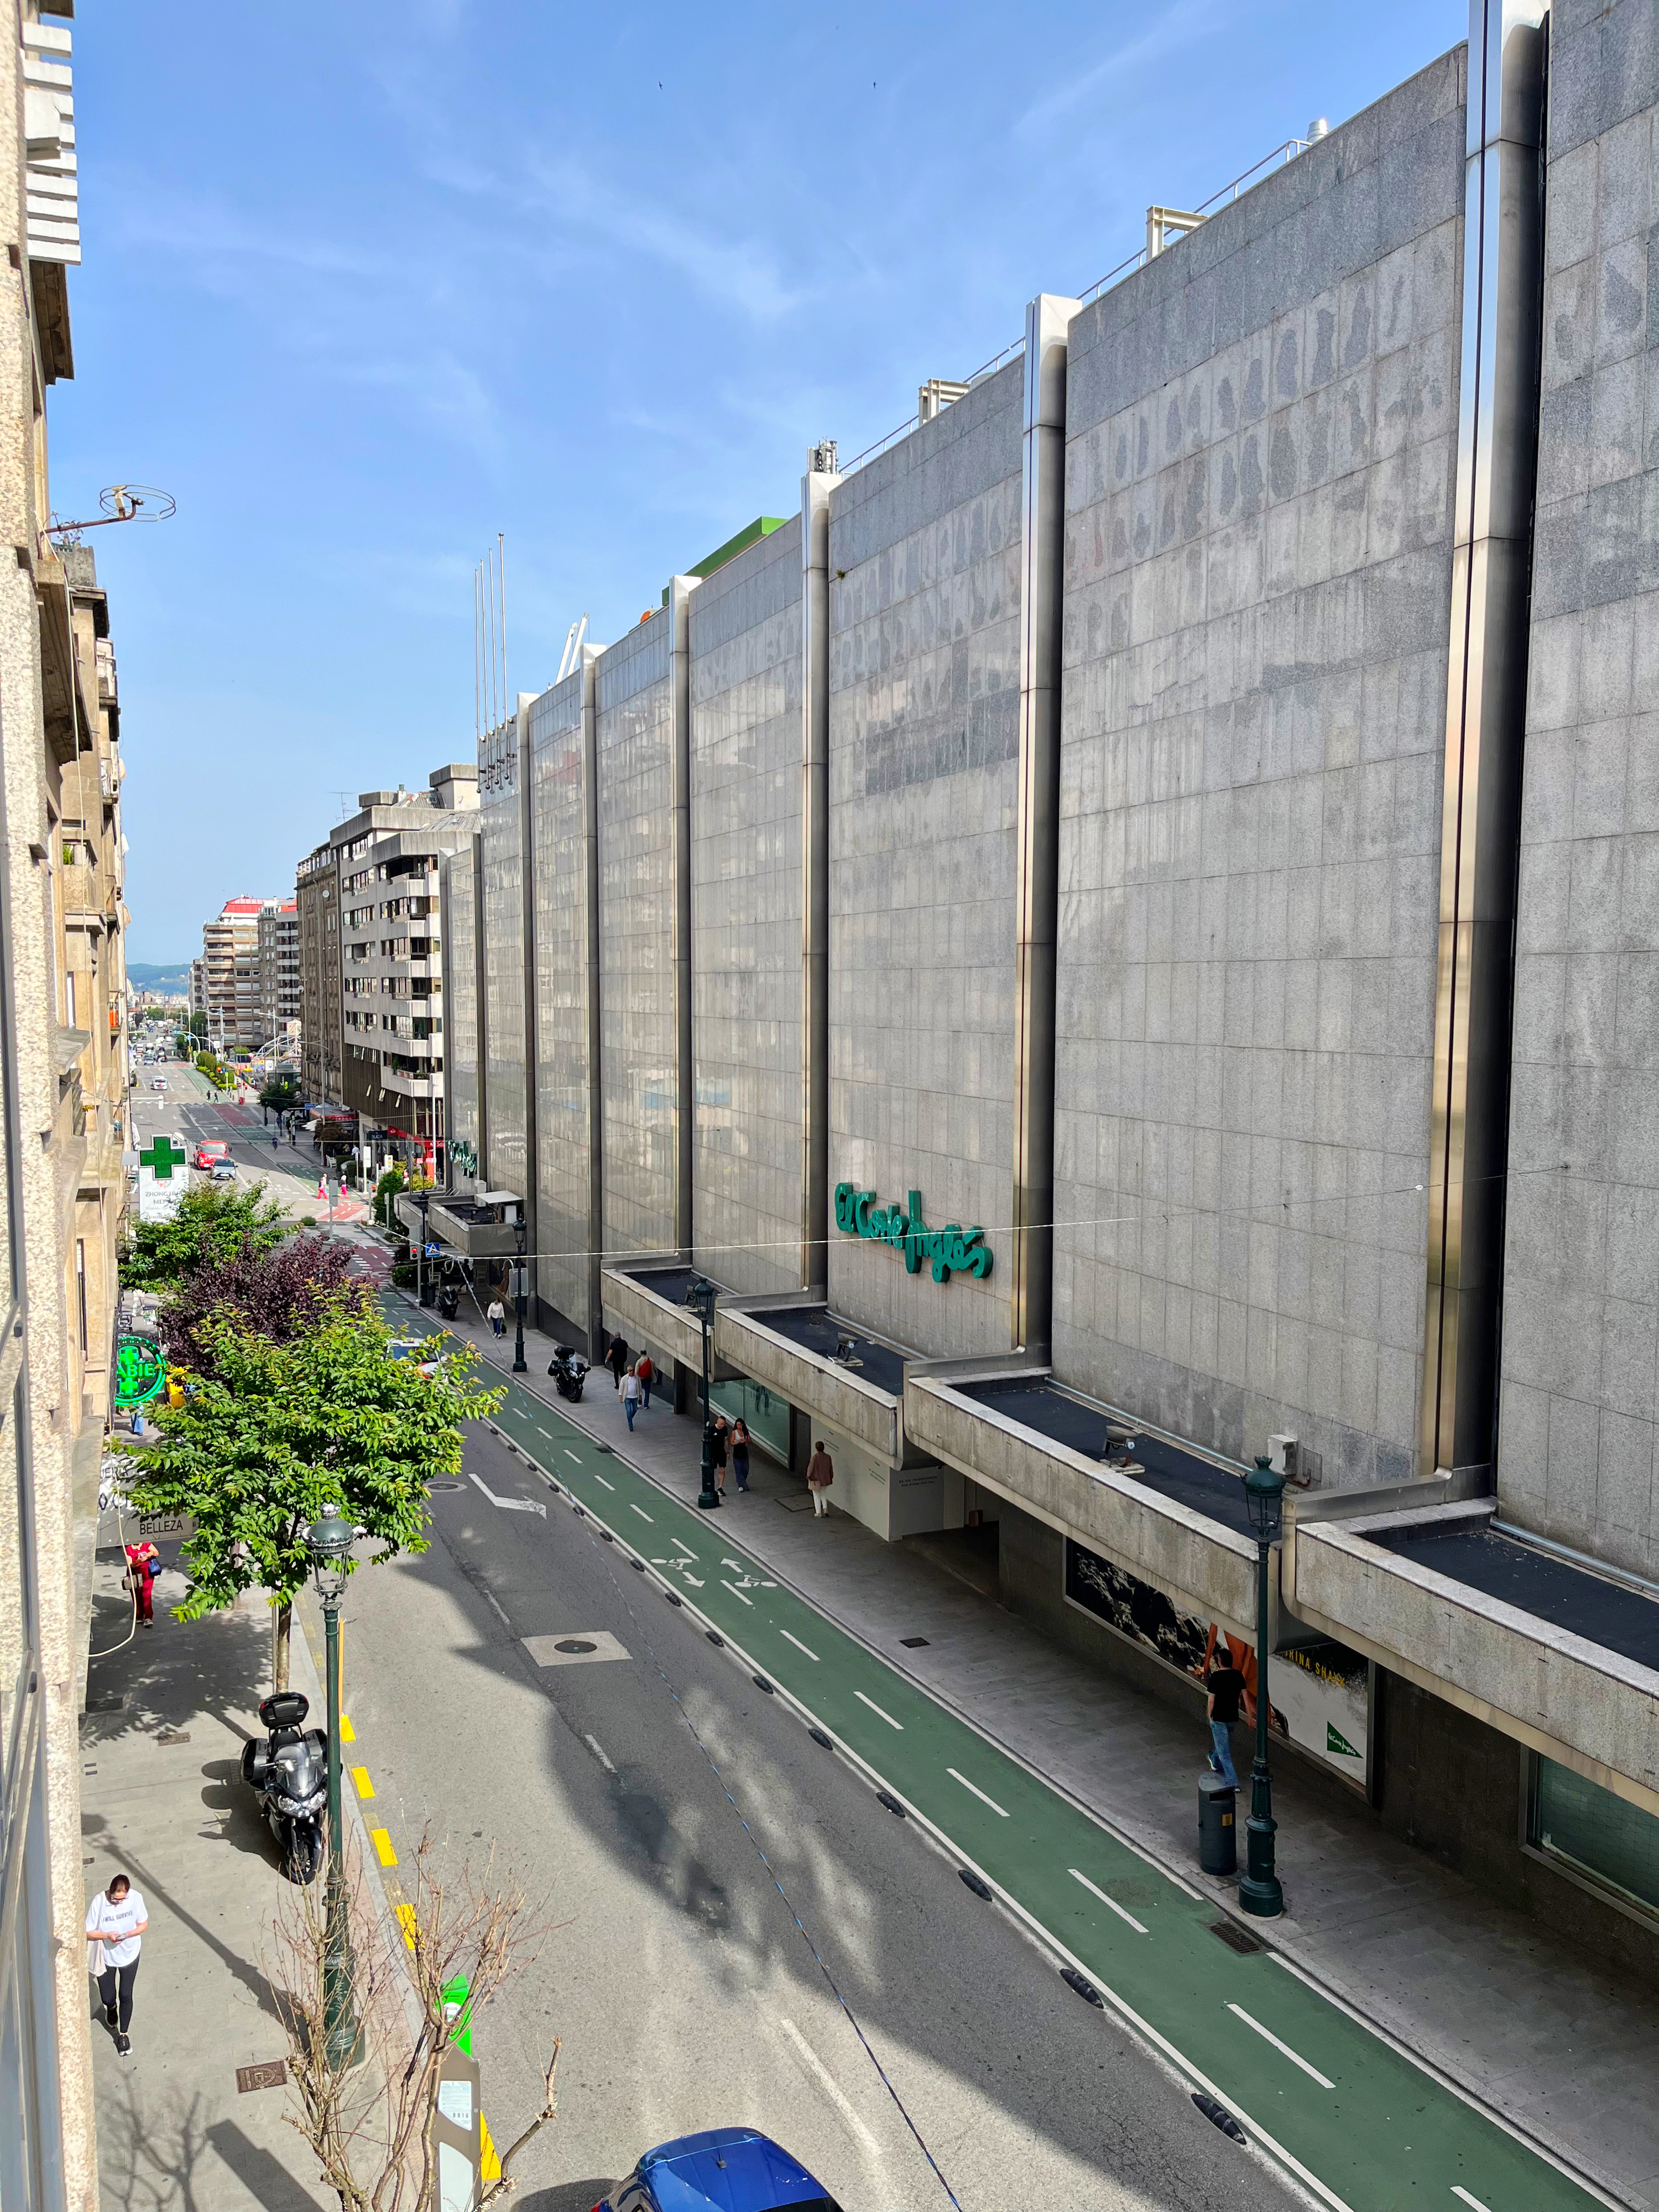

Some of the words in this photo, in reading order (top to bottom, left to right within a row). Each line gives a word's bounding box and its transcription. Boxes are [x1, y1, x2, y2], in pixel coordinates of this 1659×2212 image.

[834, 1182, 858, 1233] El
[855, 1192, 909, 1250] Corte
[905, 1190, 994, 1283] Inglés
[140, 1520, 184, 1535] BELLEZA
[116, 1910, 133, 1920] SURVIVE
